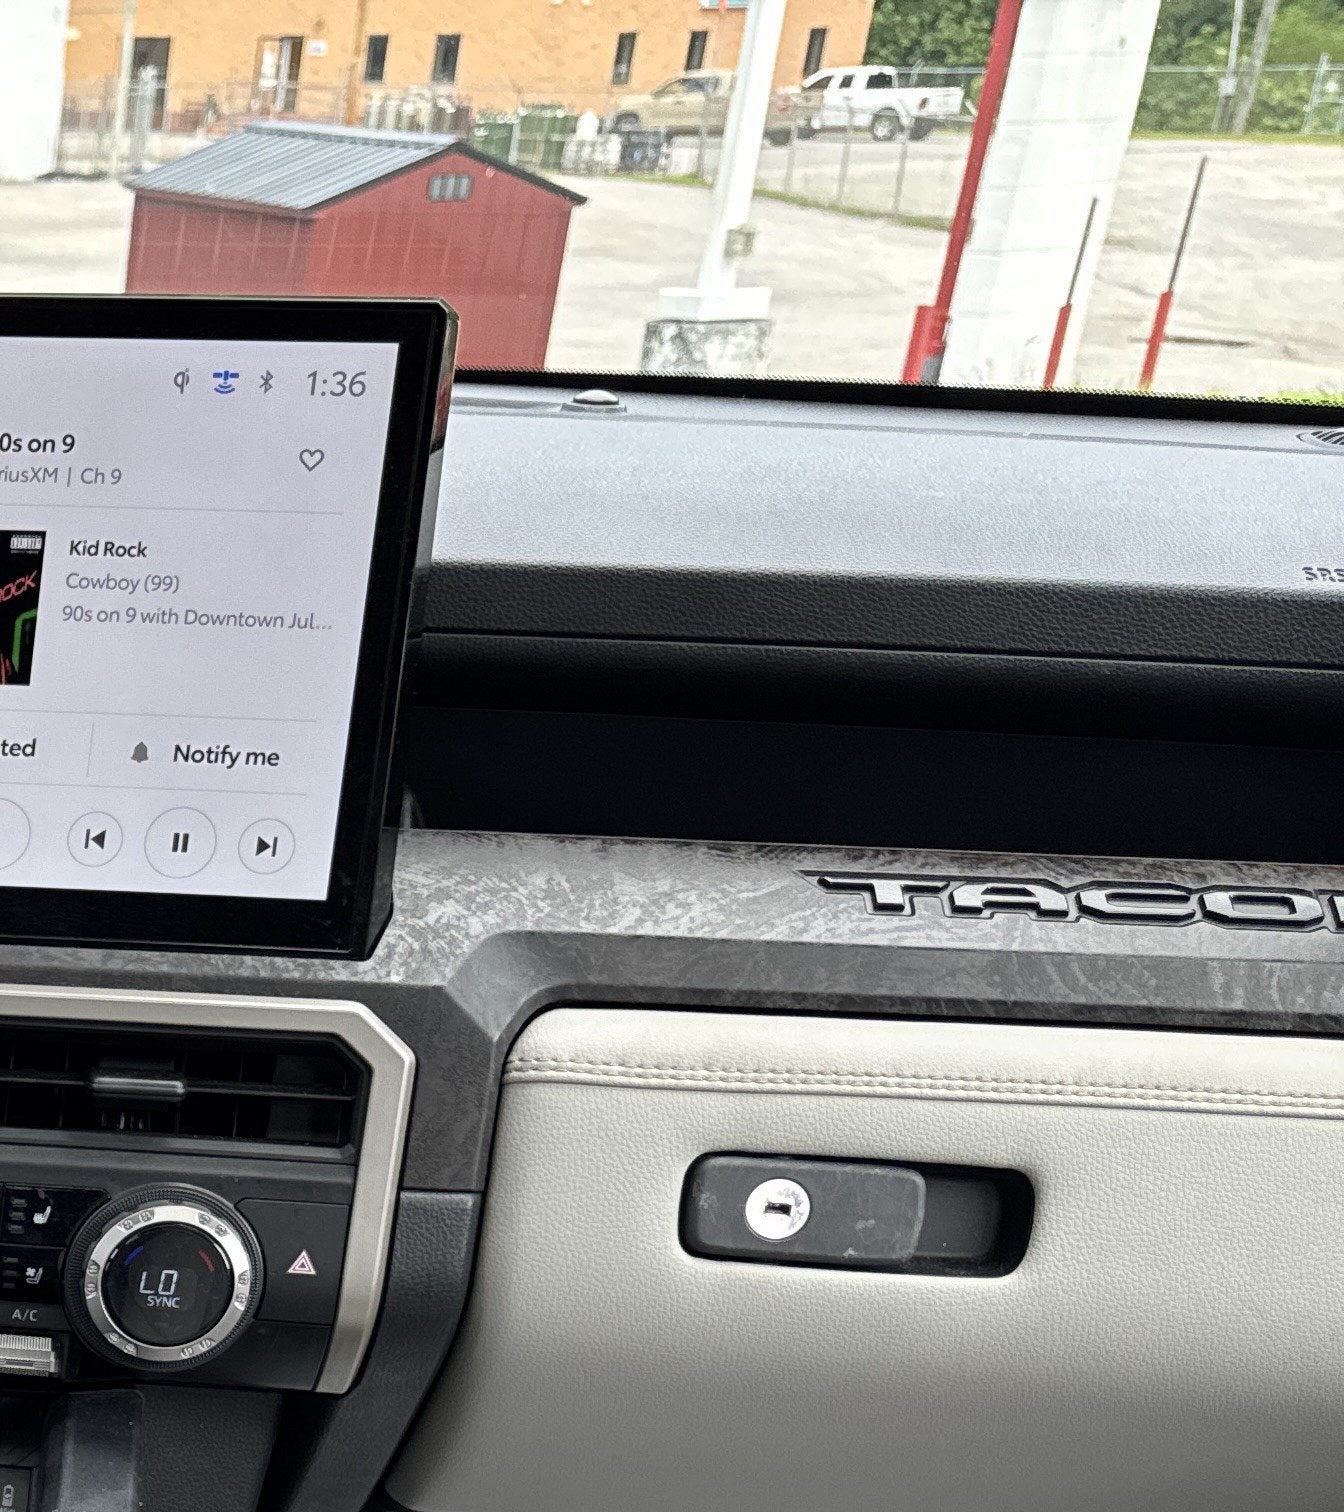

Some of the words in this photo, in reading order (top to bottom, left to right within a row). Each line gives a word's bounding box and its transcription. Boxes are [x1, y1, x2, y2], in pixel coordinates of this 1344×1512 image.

[306, 370, 367, 398] 1:36
[27, 436, 56, 454] on
[61, 434, 76, 455] 9
[80, 466, 105, 485] Ch
[110, 468, 123, 486] 9
[69, 539, 99, 558] Kid
[103, 540, 148, 560] Rock
[65, 572, 141, 594] Cowboy
[144, 573, 180, 595] (99)
[61, 604, 94, 625] 90s
[96, 608, 120, 626] on
[125, 607, 138, 626] 9
[140, 606, 179, 626] with
[183, 608, 285, 629] Downtown
[173, 743, 241, 770] Notify
[244, 750, 280, 767] me
[796, 870, 1344, 934] TACO
[139, 1269, 178, 1296] LO
[147, 1295, 180, 1309] SYNC
[12, 1308, 39, 1322] A/C
